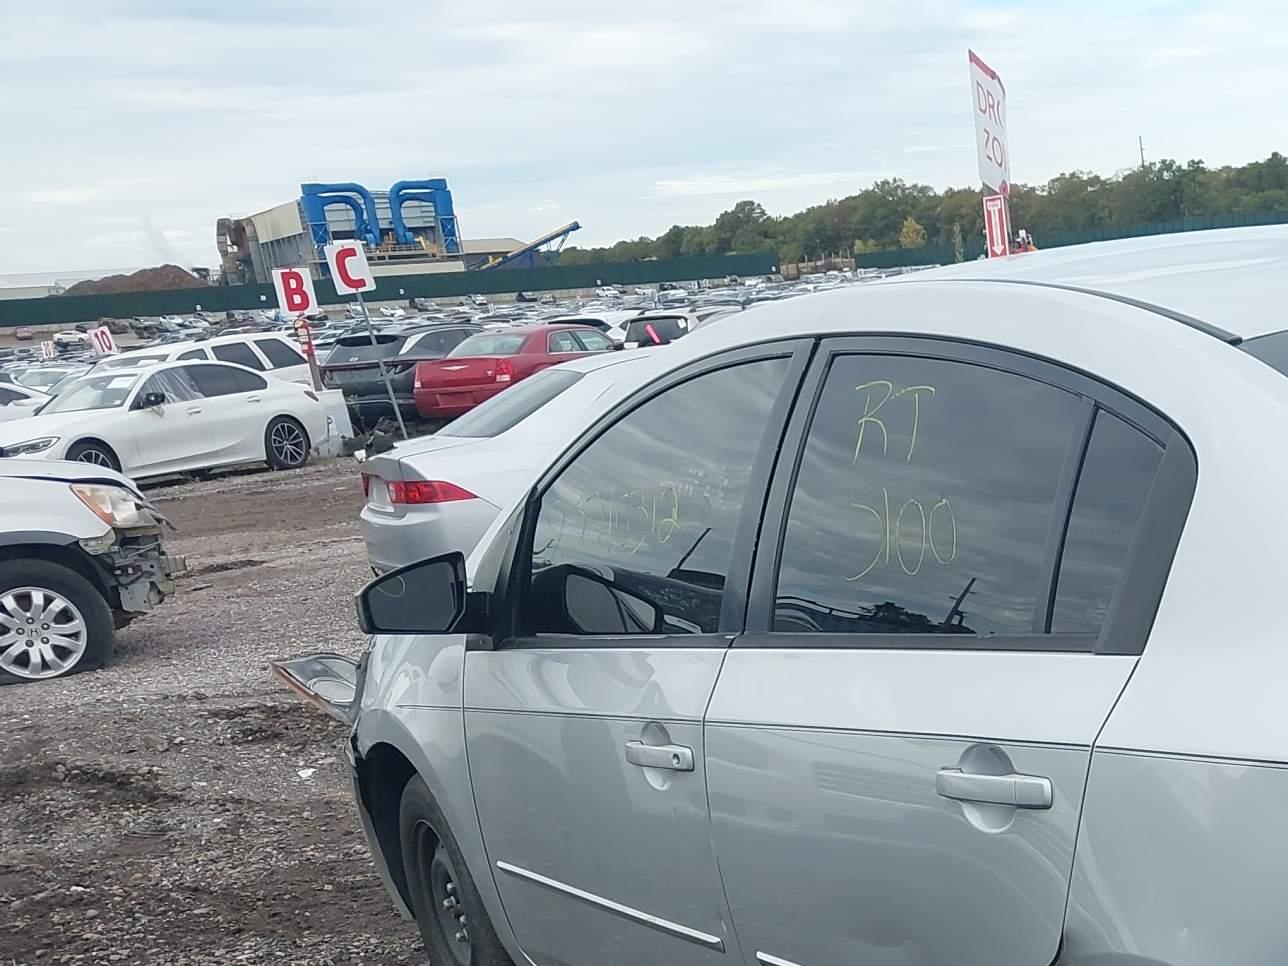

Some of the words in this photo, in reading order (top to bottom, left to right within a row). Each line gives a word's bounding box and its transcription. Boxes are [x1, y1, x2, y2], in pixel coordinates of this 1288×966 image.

[334, 247, 367, 290] C
[280, 270, 310, 313] B
[93, 330, 113, 353] 10
[852, 380, 936, 468] RT
